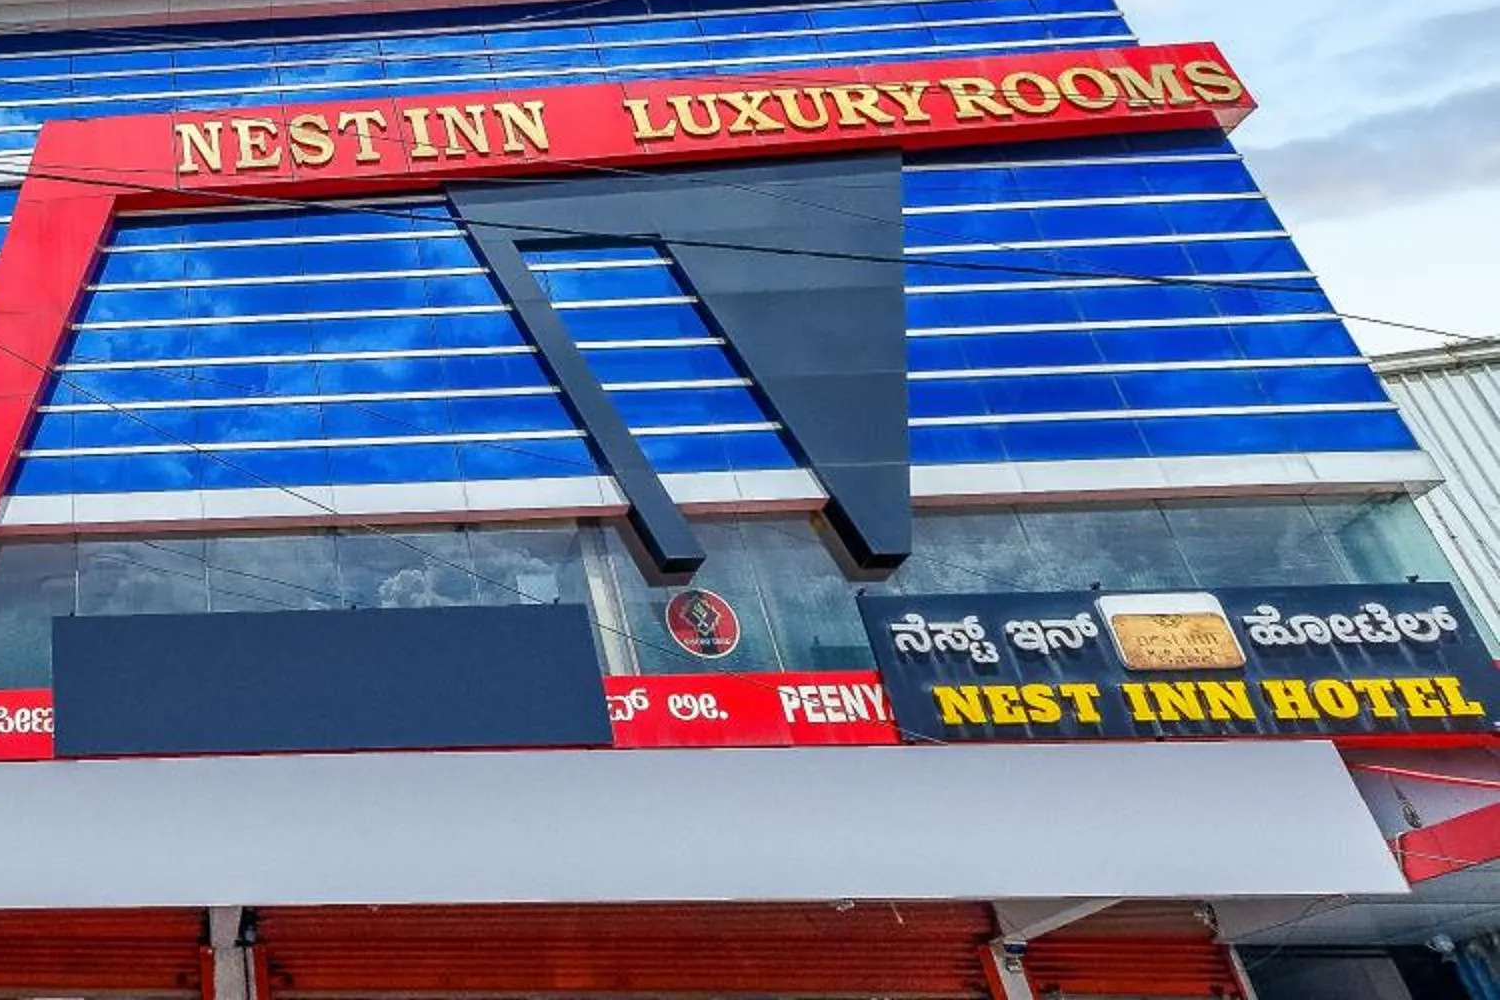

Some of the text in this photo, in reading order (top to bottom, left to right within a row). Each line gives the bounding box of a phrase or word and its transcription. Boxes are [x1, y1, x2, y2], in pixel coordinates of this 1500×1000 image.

[175, 58, 1245, 173] NEST INN LUXURY ROOMS
[1005, 612, 1099, 655] ಇನ್
[777, 683, 895, 723] PEENY
[932, 675, 1486, 725] NEST INN HOTEL
